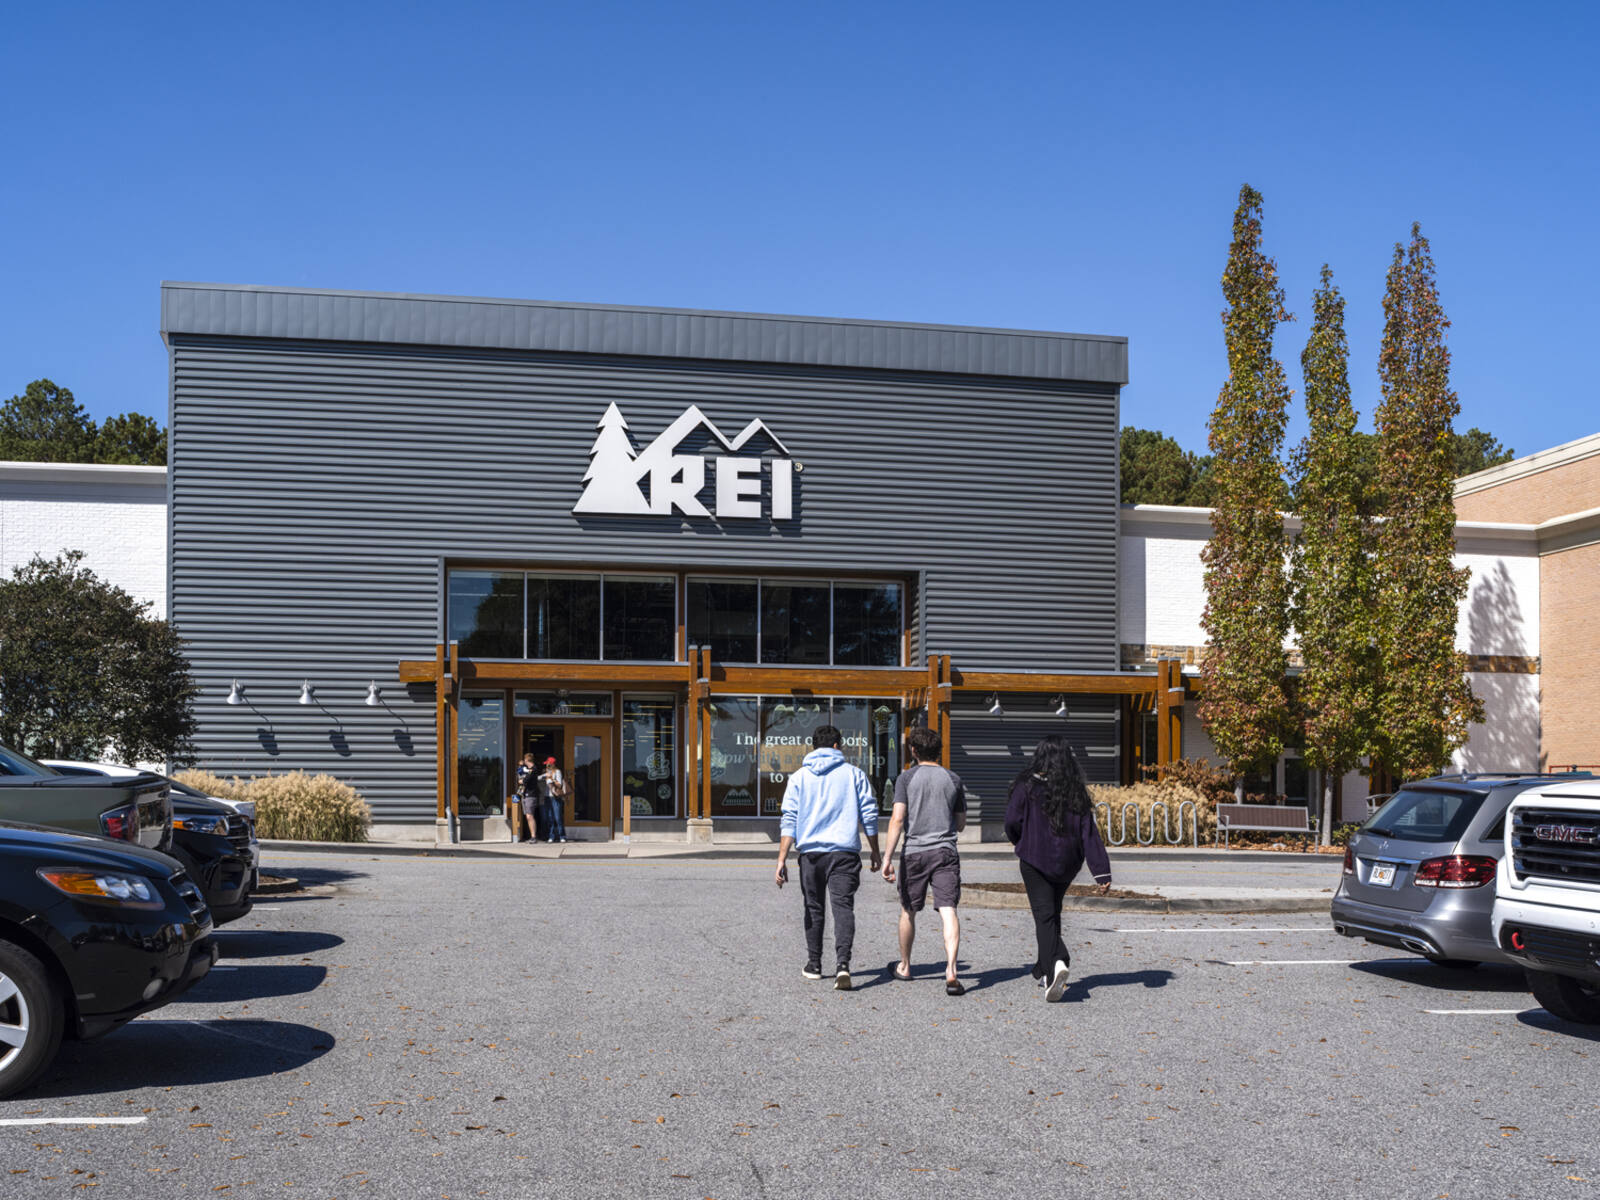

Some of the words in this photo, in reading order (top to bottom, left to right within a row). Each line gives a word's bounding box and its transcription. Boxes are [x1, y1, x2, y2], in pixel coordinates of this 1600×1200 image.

[650, 455, 793, 520] REI
[765, 735, 801, 748] great
[805, 735, 868, 748] ooors
[769, 772, 784, 783] to
[1536, 825, 1592, 843] GMC
